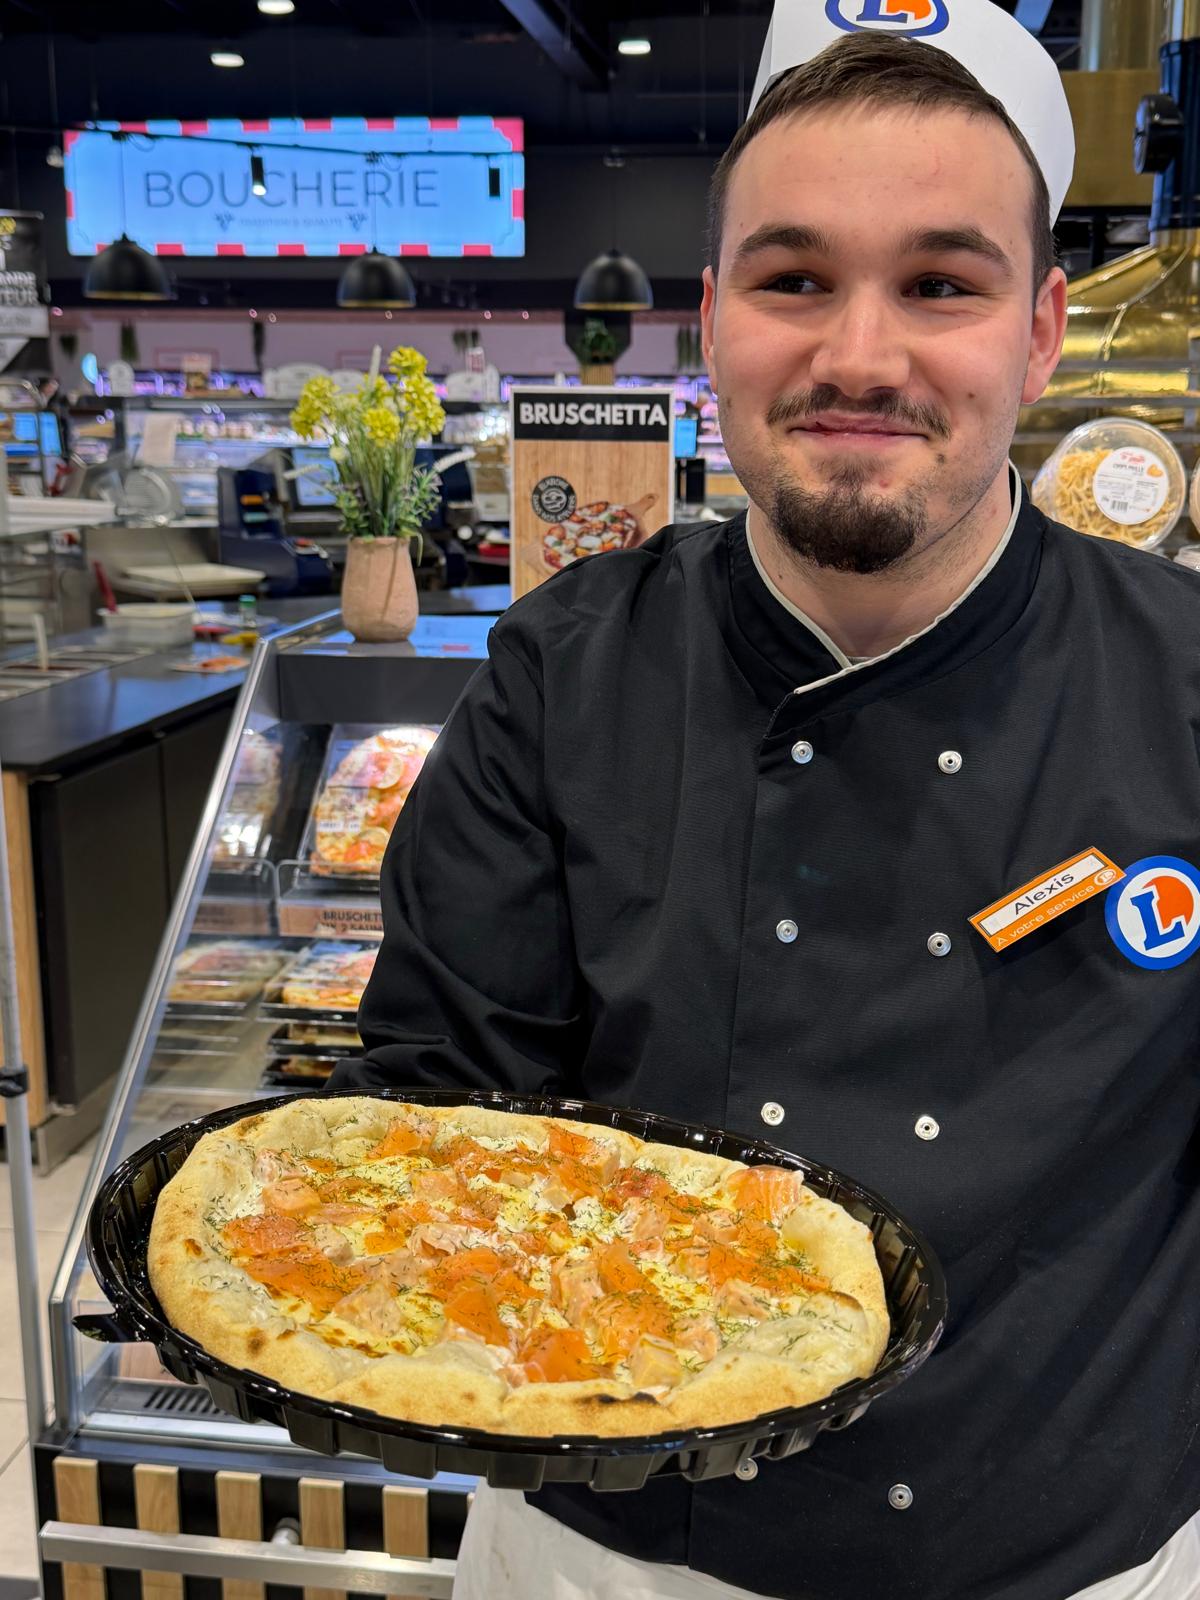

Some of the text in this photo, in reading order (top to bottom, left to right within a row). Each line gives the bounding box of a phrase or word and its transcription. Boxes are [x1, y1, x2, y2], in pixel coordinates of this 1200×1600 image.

[145, 170, 439, 208] BOUCHERIE
[520, 403, 667, 426] BRUSCHETTA
[1010, 916, 1045, 940] votre
[1047, 885, 1095, 915] service
[1014, 873, 1075, 915] Alexis
